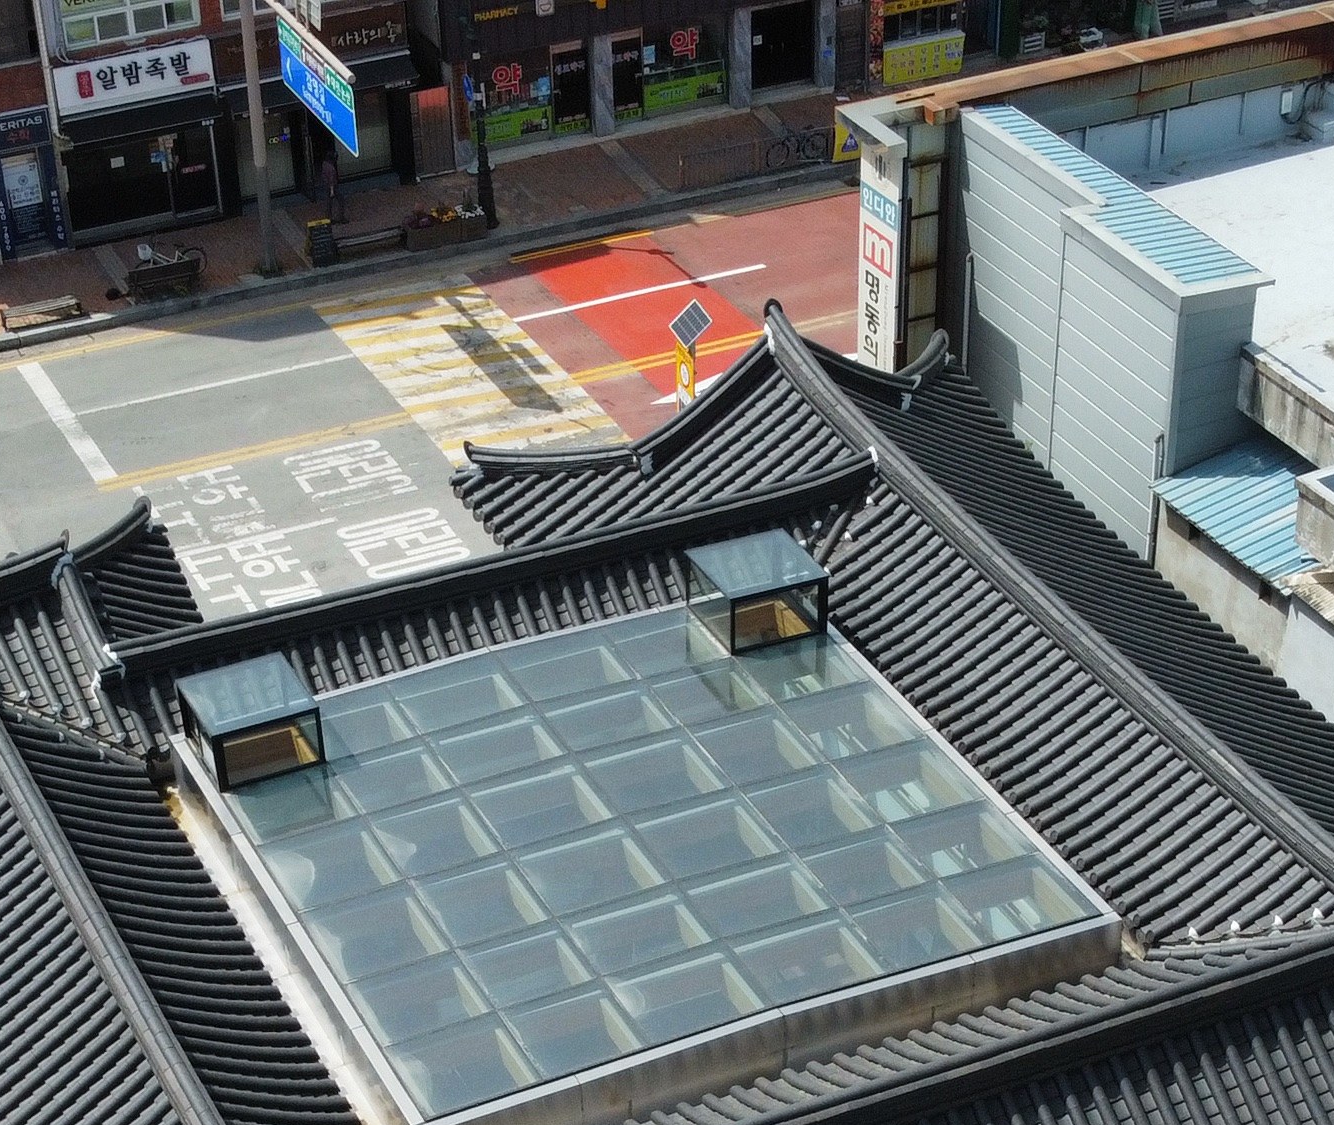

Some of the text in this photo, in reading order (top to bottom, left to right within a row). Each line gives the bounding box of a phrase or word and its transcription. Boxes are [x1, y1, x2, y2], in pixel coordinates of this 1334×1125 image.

[474, 6, 518, 22] PHARMACY
[670, 27, 700, 60] 약
[96, 51, 191, 91] 알밤족발
[492, 63, 522, 95] 약
[862, 188, 896, 226] 인디안
